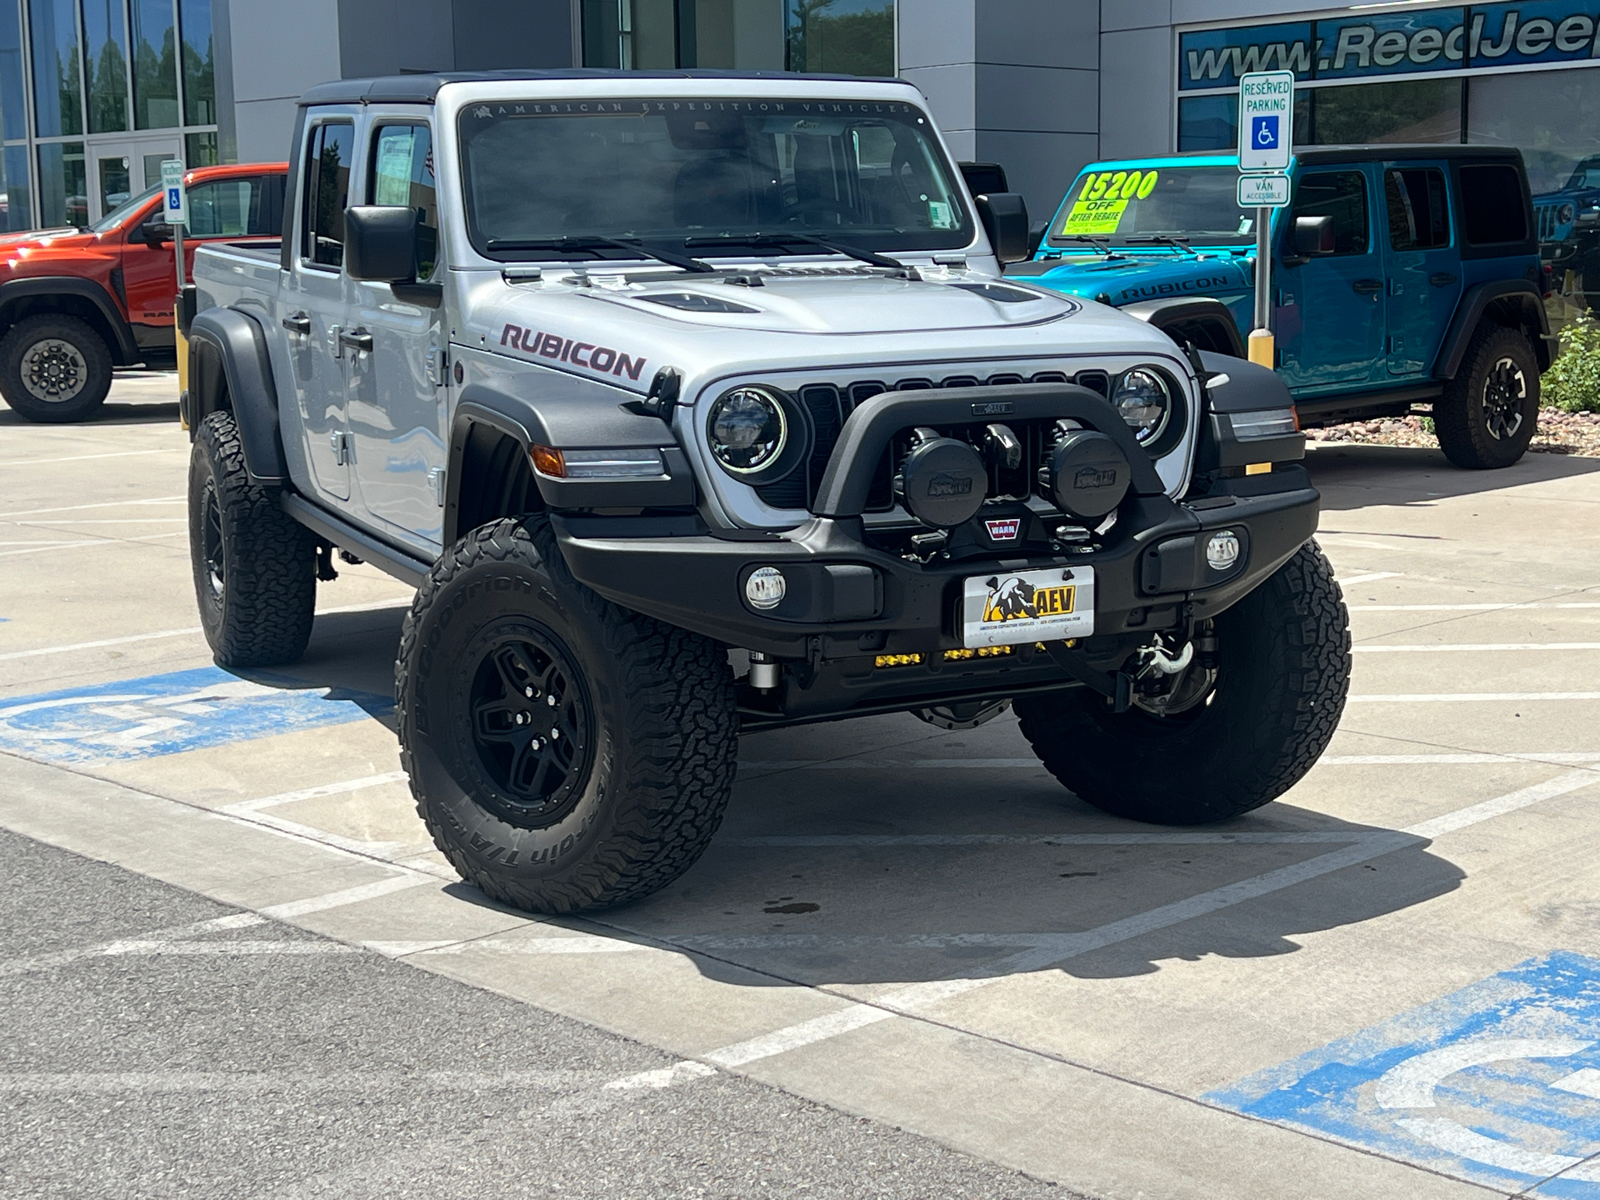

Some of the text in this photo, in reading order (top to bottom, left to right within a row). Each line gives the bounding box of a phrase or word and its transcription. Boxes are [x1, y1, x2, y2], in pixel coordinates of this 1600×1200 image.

[1187, 11, 1600, 81] www.ReedJee
[1244, 81, 1290, 96] RESERVED
[498, 102, 909, 114] AMERICAN EXPEDITION VEHICLES
[1246, 98, 1286, 112] PARKING
[1078, 170, 1158, 201] 15200
[1255, 181, 1274, 191] VAN
[1245, 192, 1282, 200] ACCESSIBLE
[1086, 201, 1117, 211] OFF
[1069, 211, 1121, 222] AFTER REBATE
[1120, 275, 1228, 300] RUBICON
[500, 323, 647, 381] RUBICON
[991, 525, 1015, 535] WARN
[1036, 587, 1072, 613] AEV
[469, 830, 519, 868] T/A
